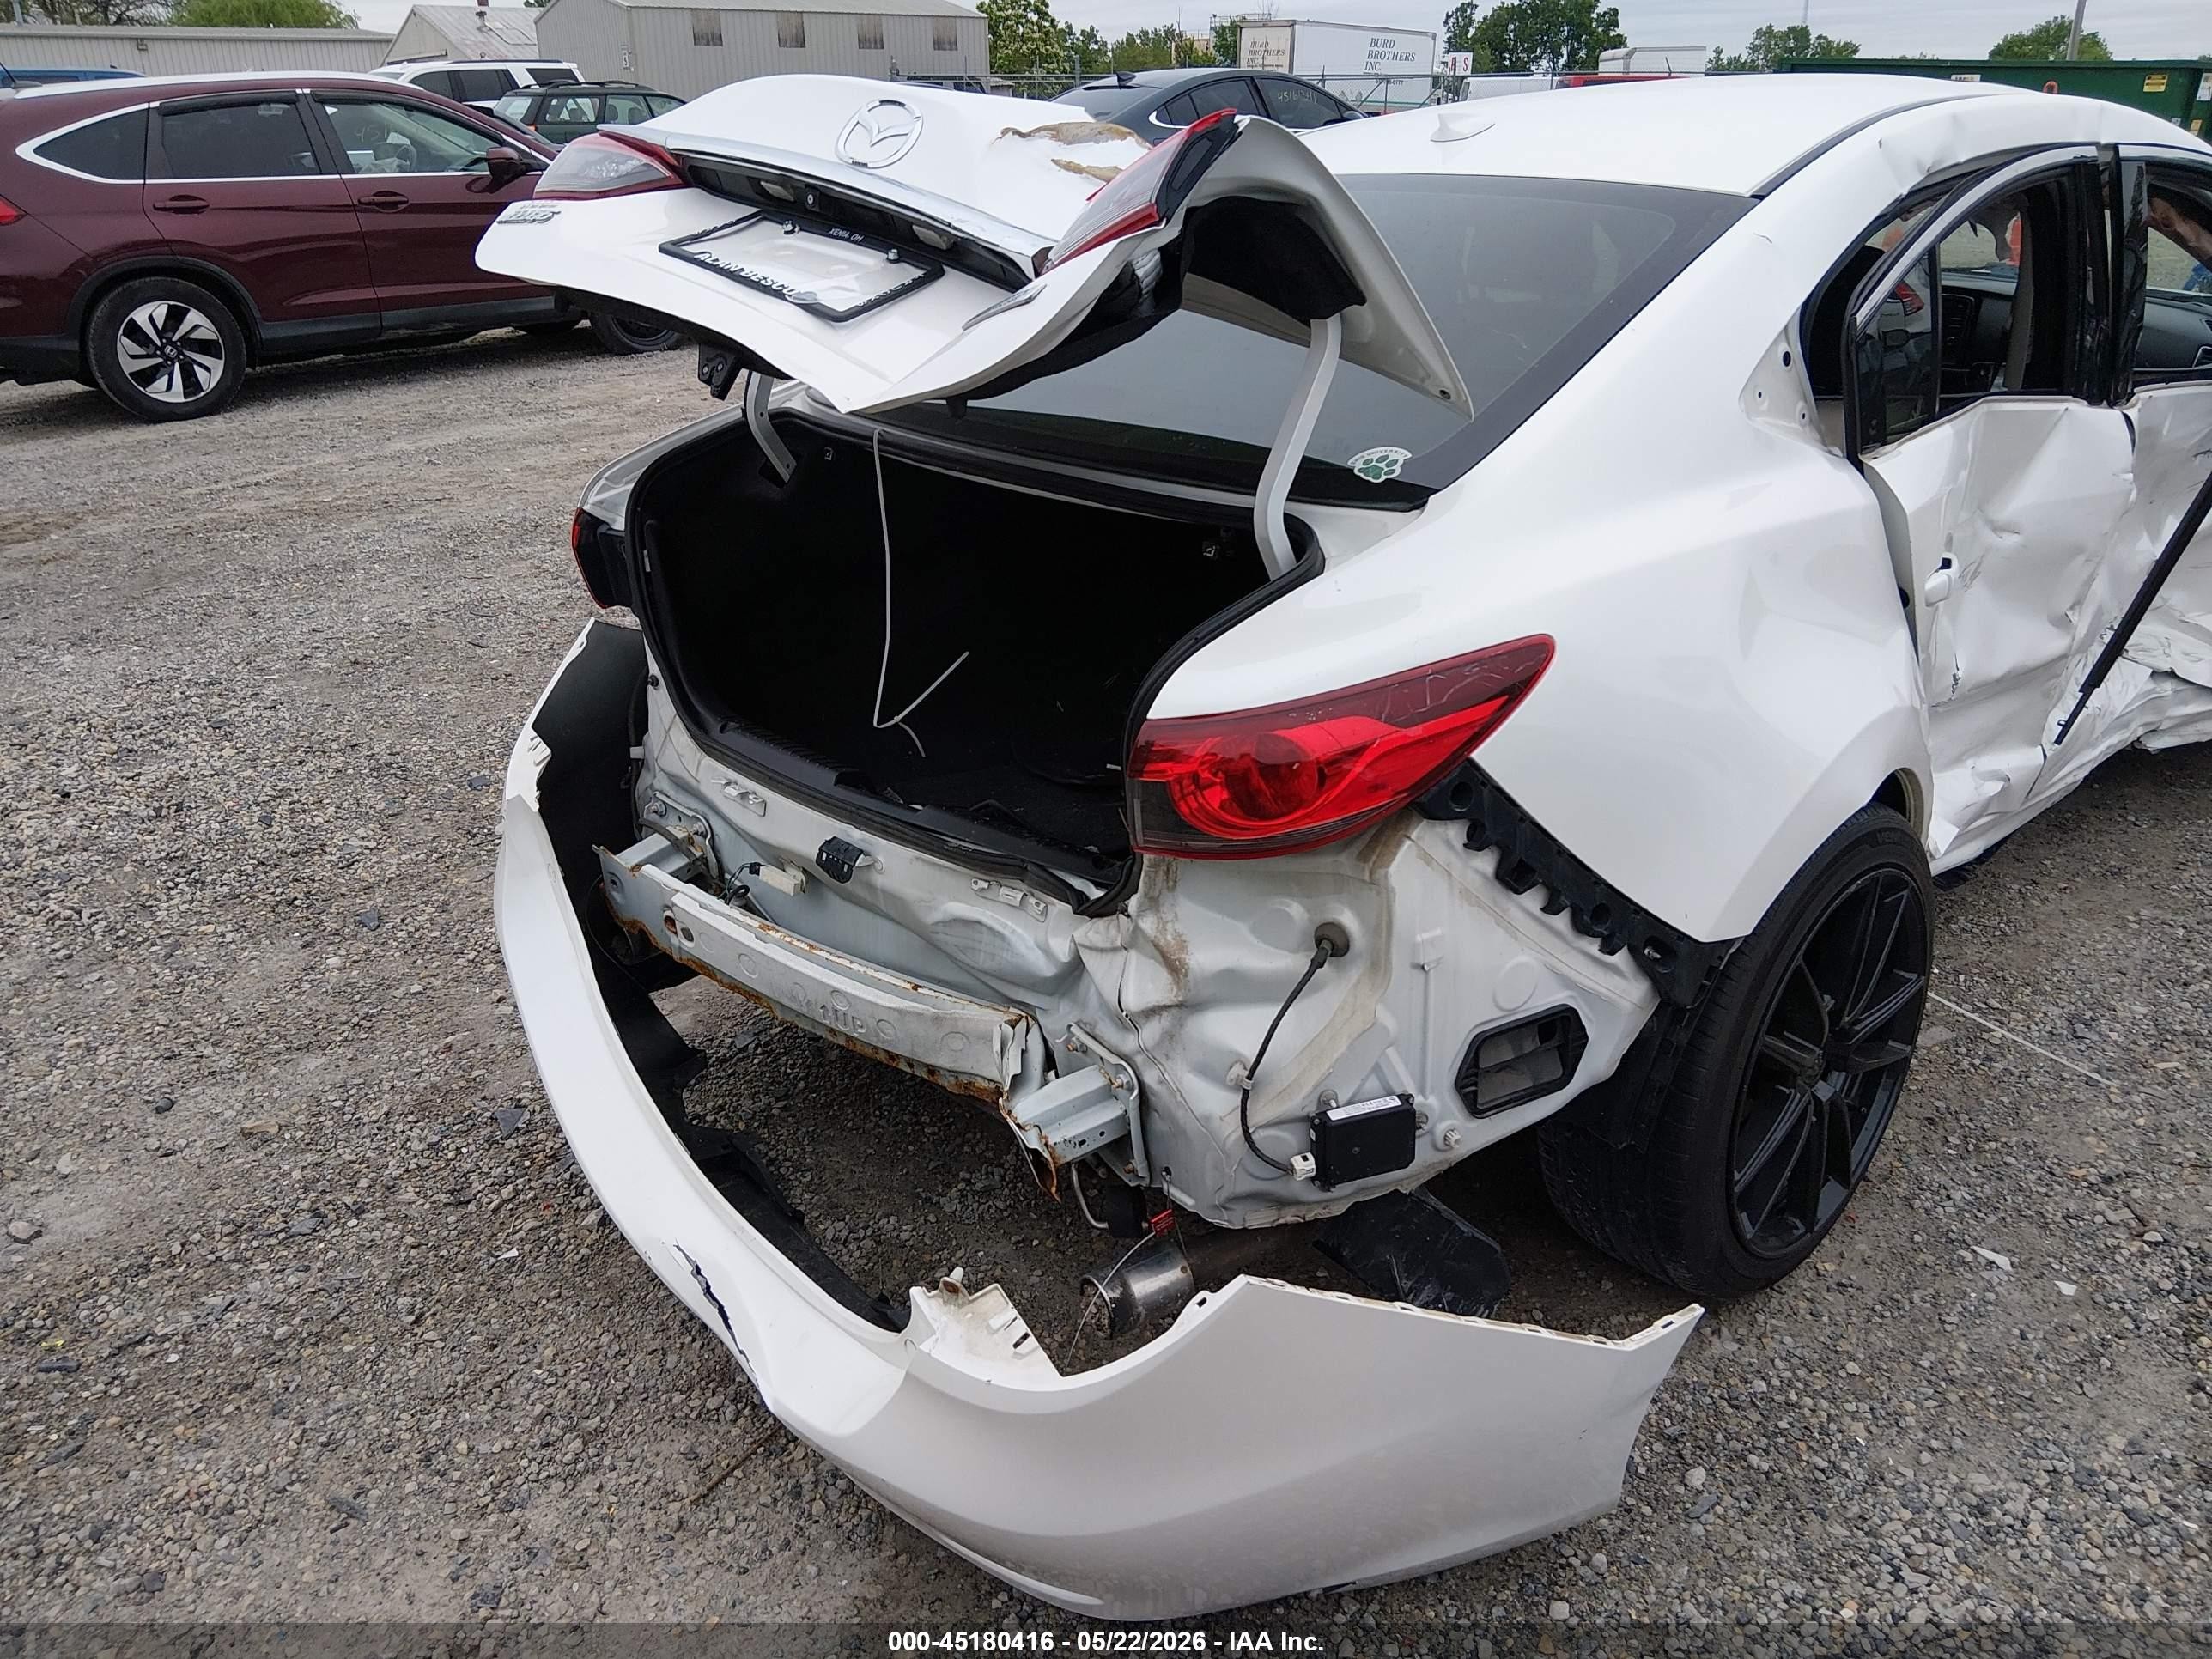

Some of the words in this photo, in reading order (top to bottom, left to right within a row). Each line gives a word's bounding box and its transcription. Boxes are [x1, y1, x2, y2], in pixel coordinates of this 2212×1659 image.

[1370, 38, 1395, 49] BURD
[1367, 50, 1415, 62] BROTHERS
[1364, 61, 1382, 71] INC.
[694, 252, 742, 273] ALAN
